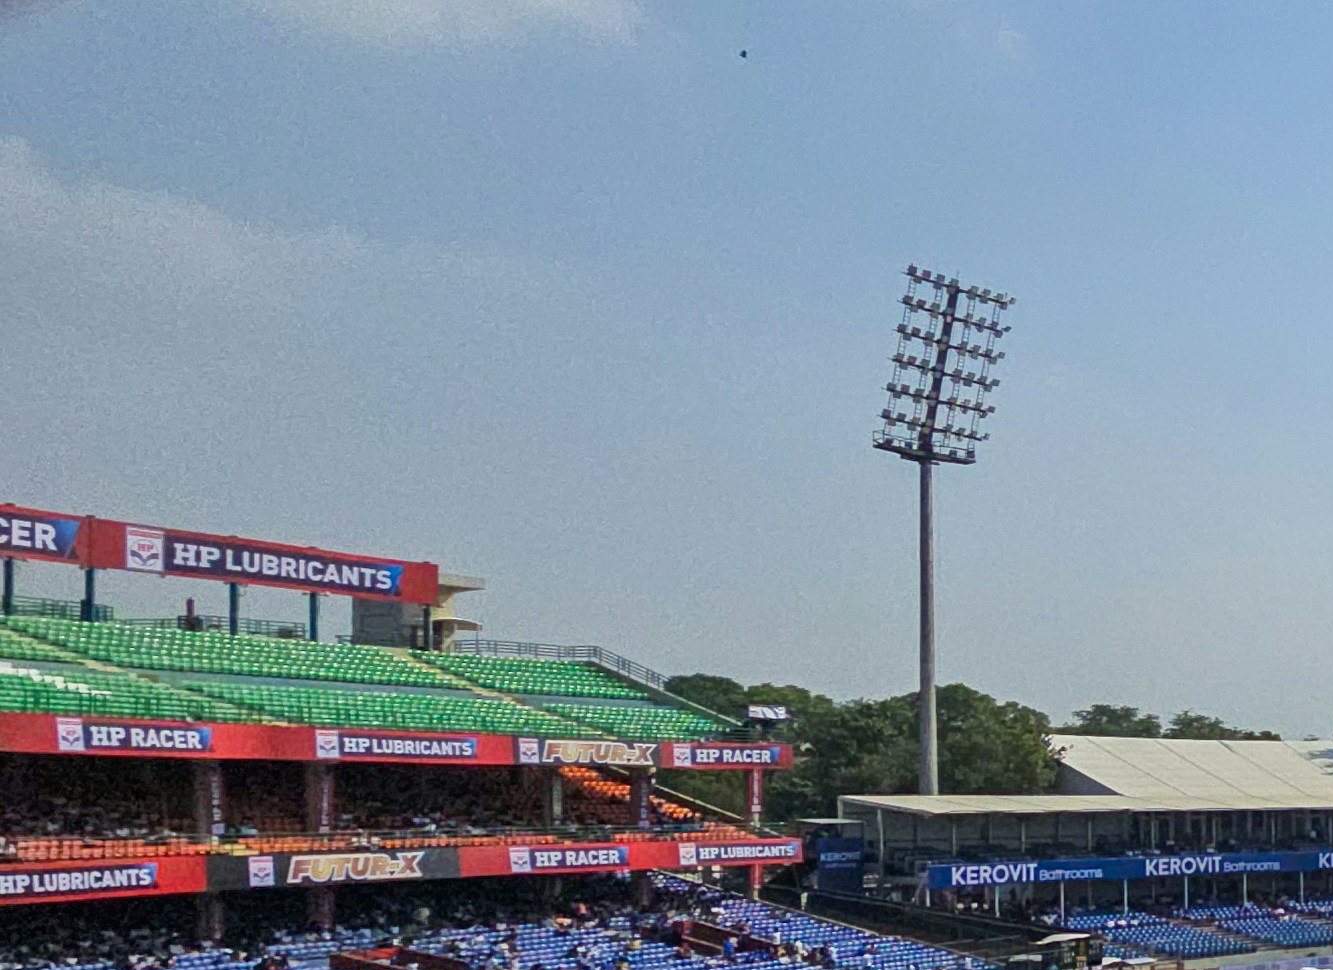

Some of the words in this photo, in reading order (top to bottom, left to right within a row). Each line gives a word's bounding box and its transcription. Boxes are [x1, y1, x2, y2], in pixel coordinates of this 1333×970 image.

[173, 542, 220, 568] HP
[225, 547, 392, 590] LUBRICANTS
[90, 726, 124, 747] HP
[129, 728, 203, 750] RACER
[343, 737, 370, 755] HP
[371, 738, 473, 758] LUBRICANTS
[543, 739, 657, 765] FUTUR-X
[695, 747, 720, 764] HP
[723, 748, 772, 764] RACER
[533, 851, 564, 867] HP
[565, 849, 621, 866] RACER
[699, 847, 718, 860] HP
[719, 845, 796, 859] LUBRICANTS
[286, 850, 425, 884] FUTUR-X
[951, 862, 1038, 886] KEROVIT
[1039, 868, 1103, 881] Bathrooms
[1145, 855, 1223, 876] KEROVIT
[1223, 859, 1281, 873] Bathrooms
[0, 873, 31, 895] HP
[32, 867, 153, 893] LUBRICANTS
